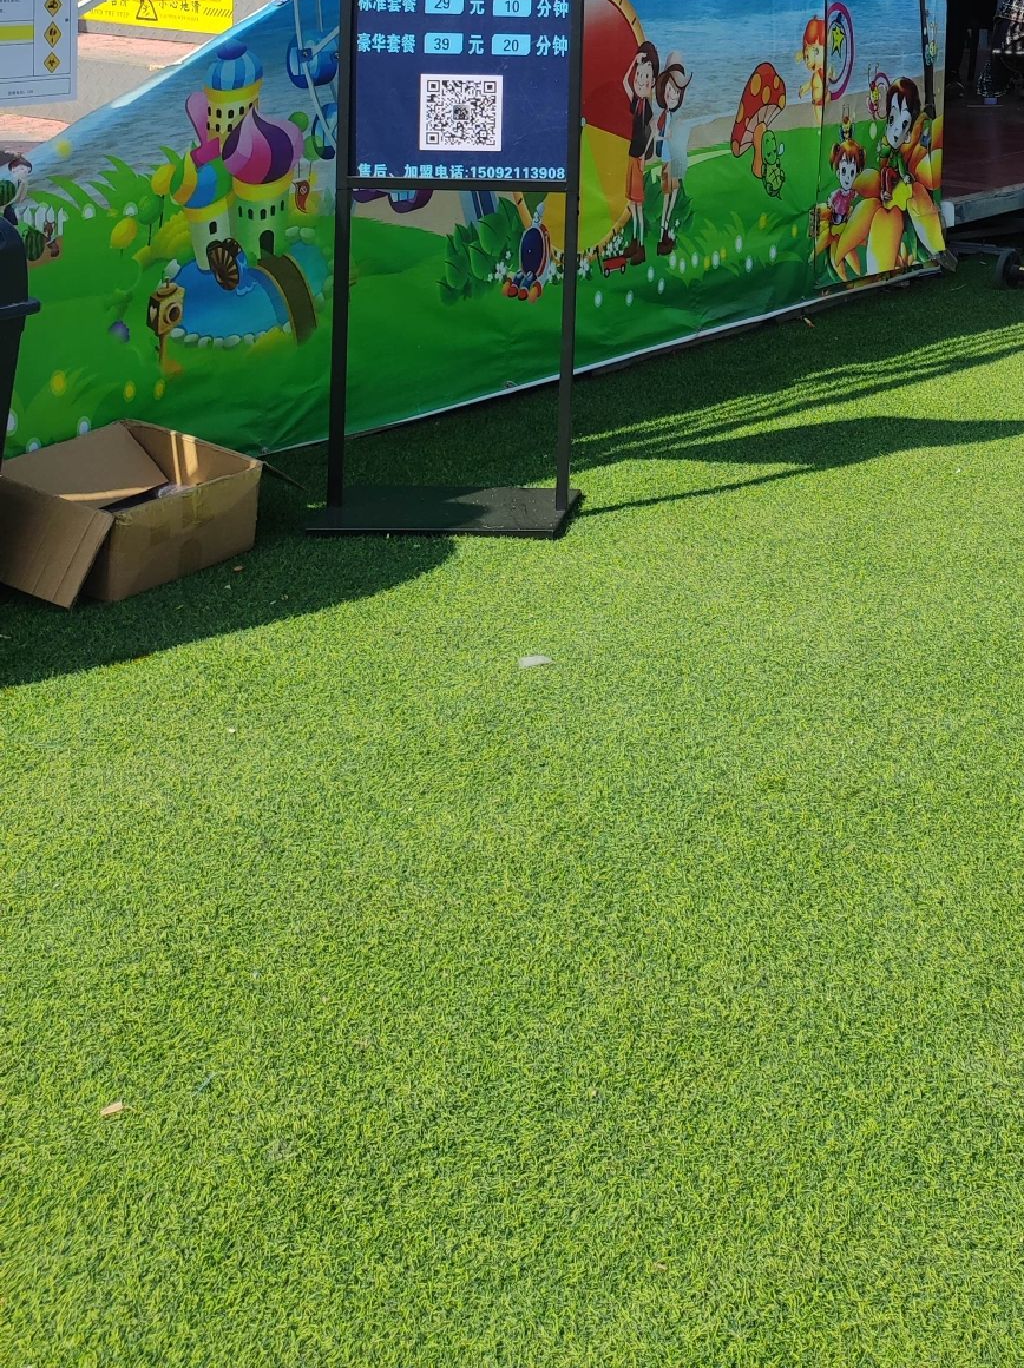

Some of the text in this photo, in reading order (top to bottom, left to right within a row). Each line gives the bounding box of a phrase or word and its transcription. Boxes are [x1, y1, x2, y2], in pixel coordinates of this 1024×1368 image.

[505, 0, 520, 13] 10
[356, 33, 568, 57] 豪华套餐 39 元 20 分钟
